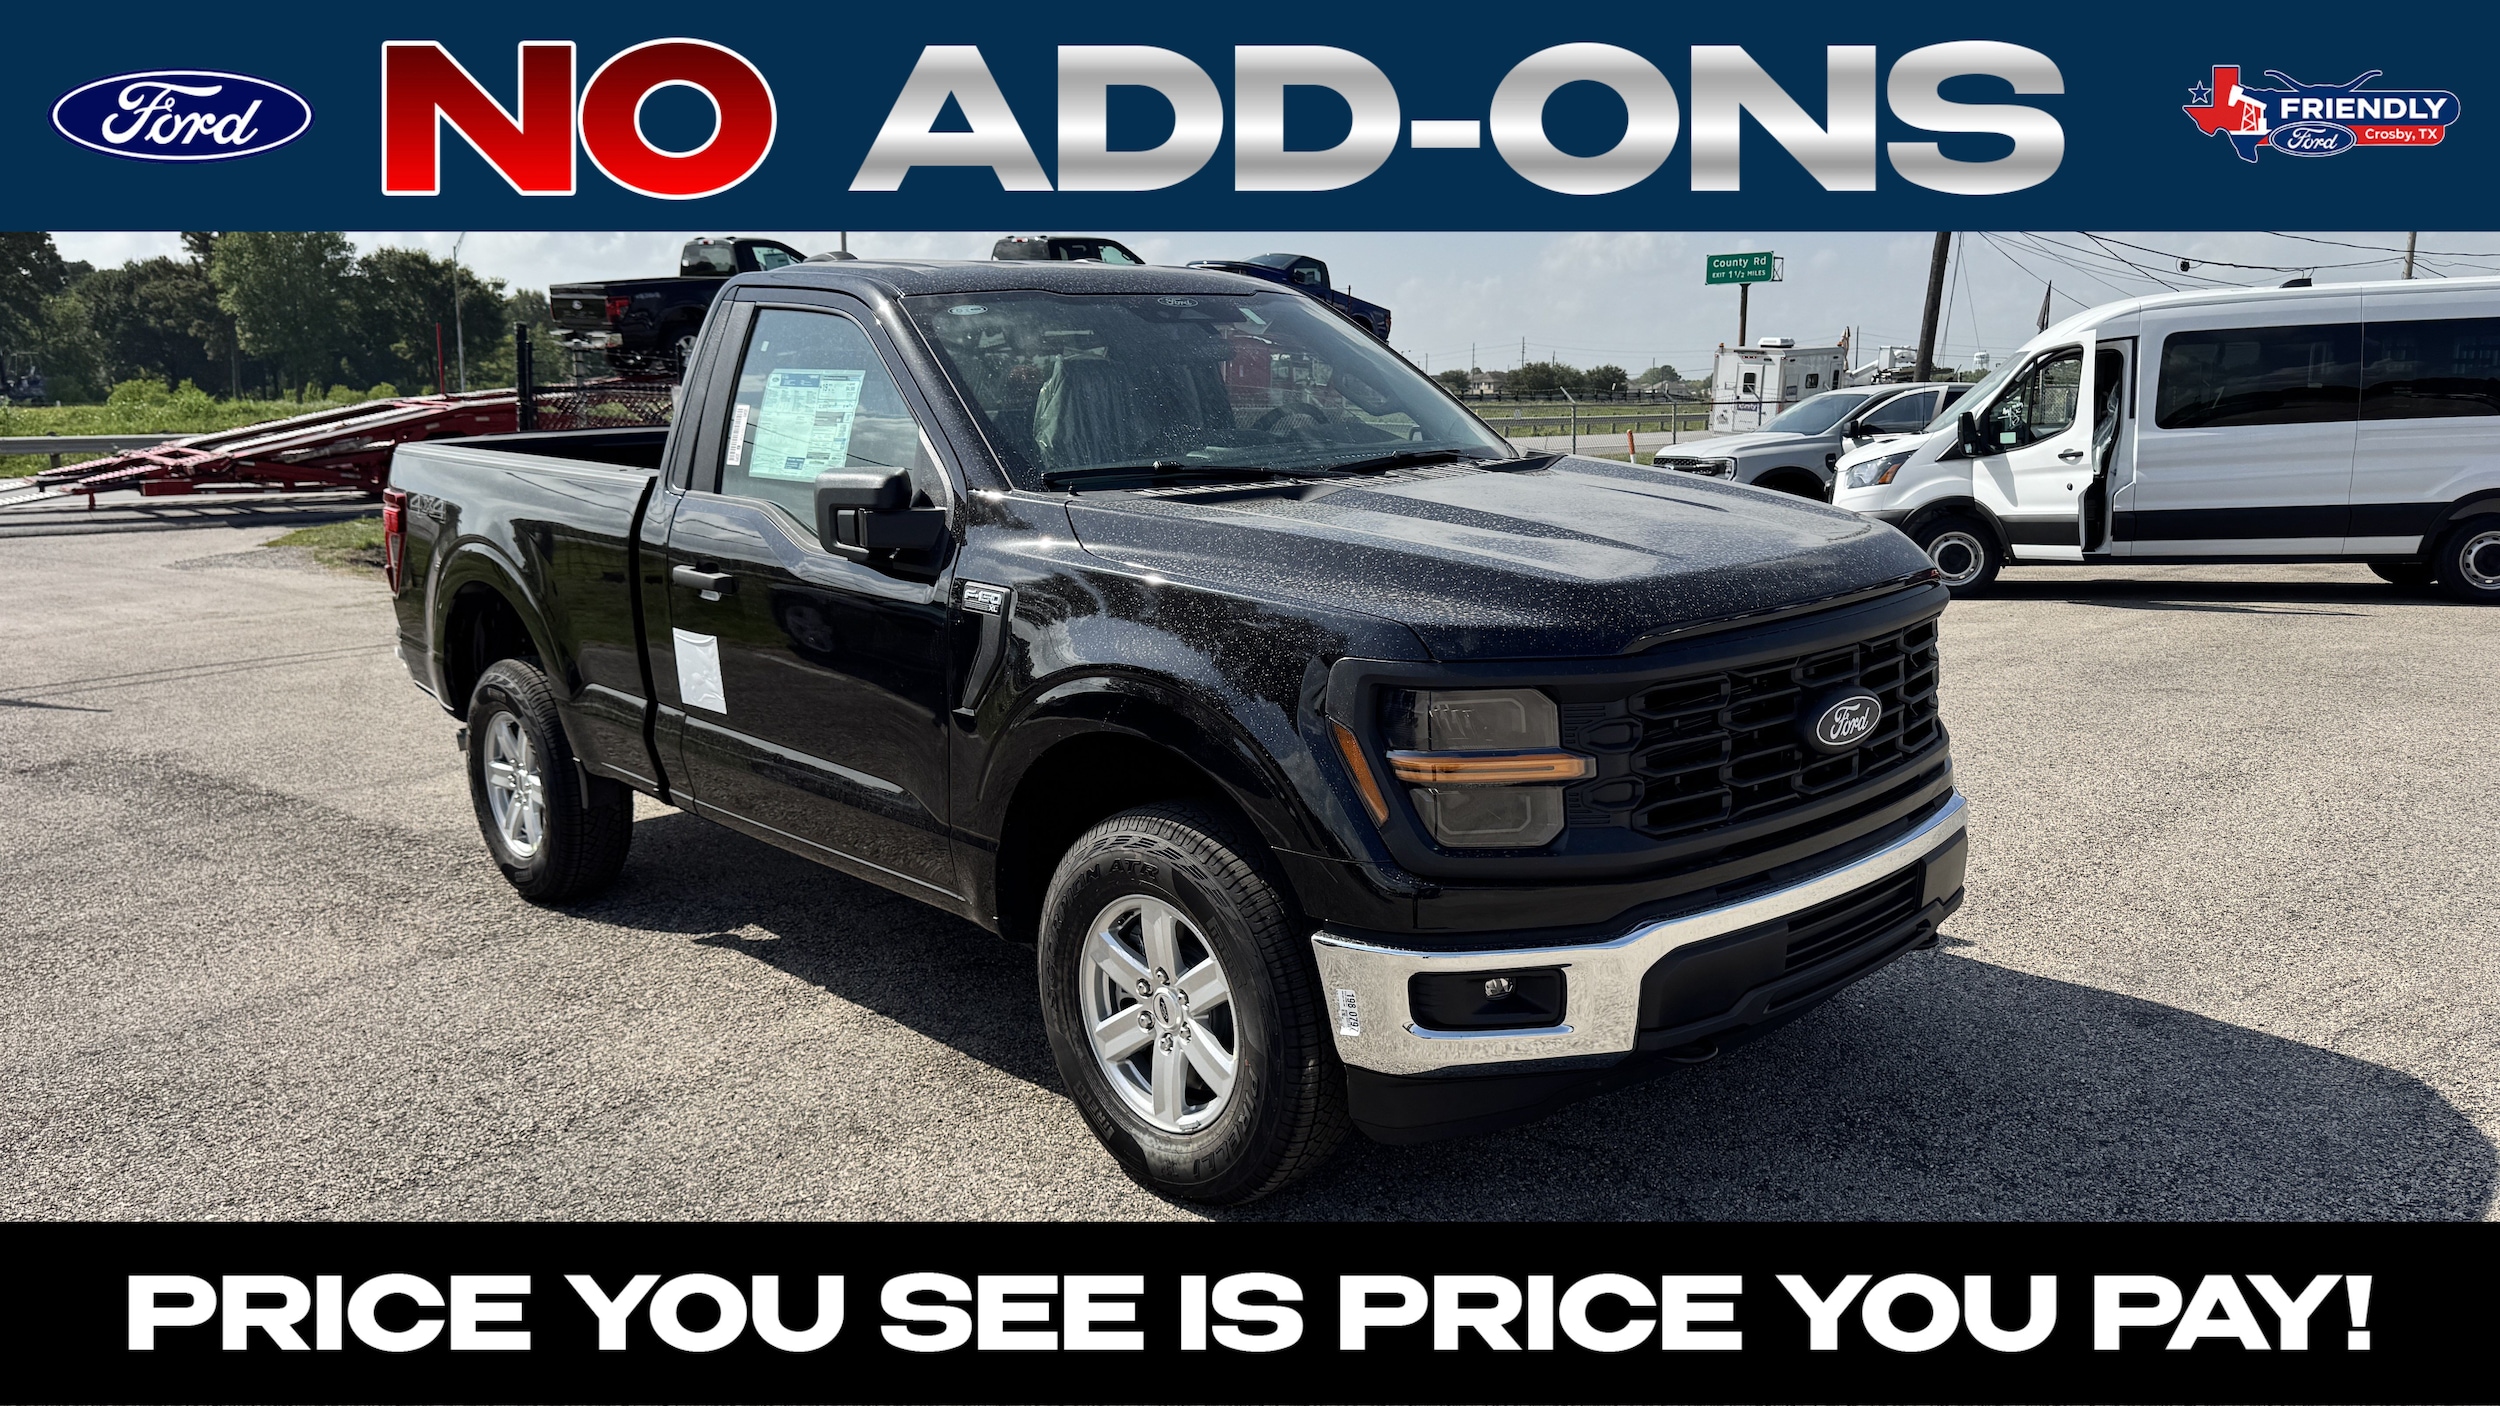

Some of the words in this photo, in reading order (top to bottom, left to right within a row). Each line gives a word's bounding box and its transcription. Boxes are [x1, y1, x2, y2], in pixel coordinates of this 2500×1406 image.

[1713, 258, 1748, 269] County
[1753, 256, 1767, 266] Rd
[1747, 269, 1766, 277] MILES
[964, 590, 1002, 606] F-150
[989, 604, 999, 613] XL
[1830, 703, 1870, 740] Ford
[1109, 858, 1160, 880] ATR
[1193, 1065, 1260, 1178] PIRELLI
